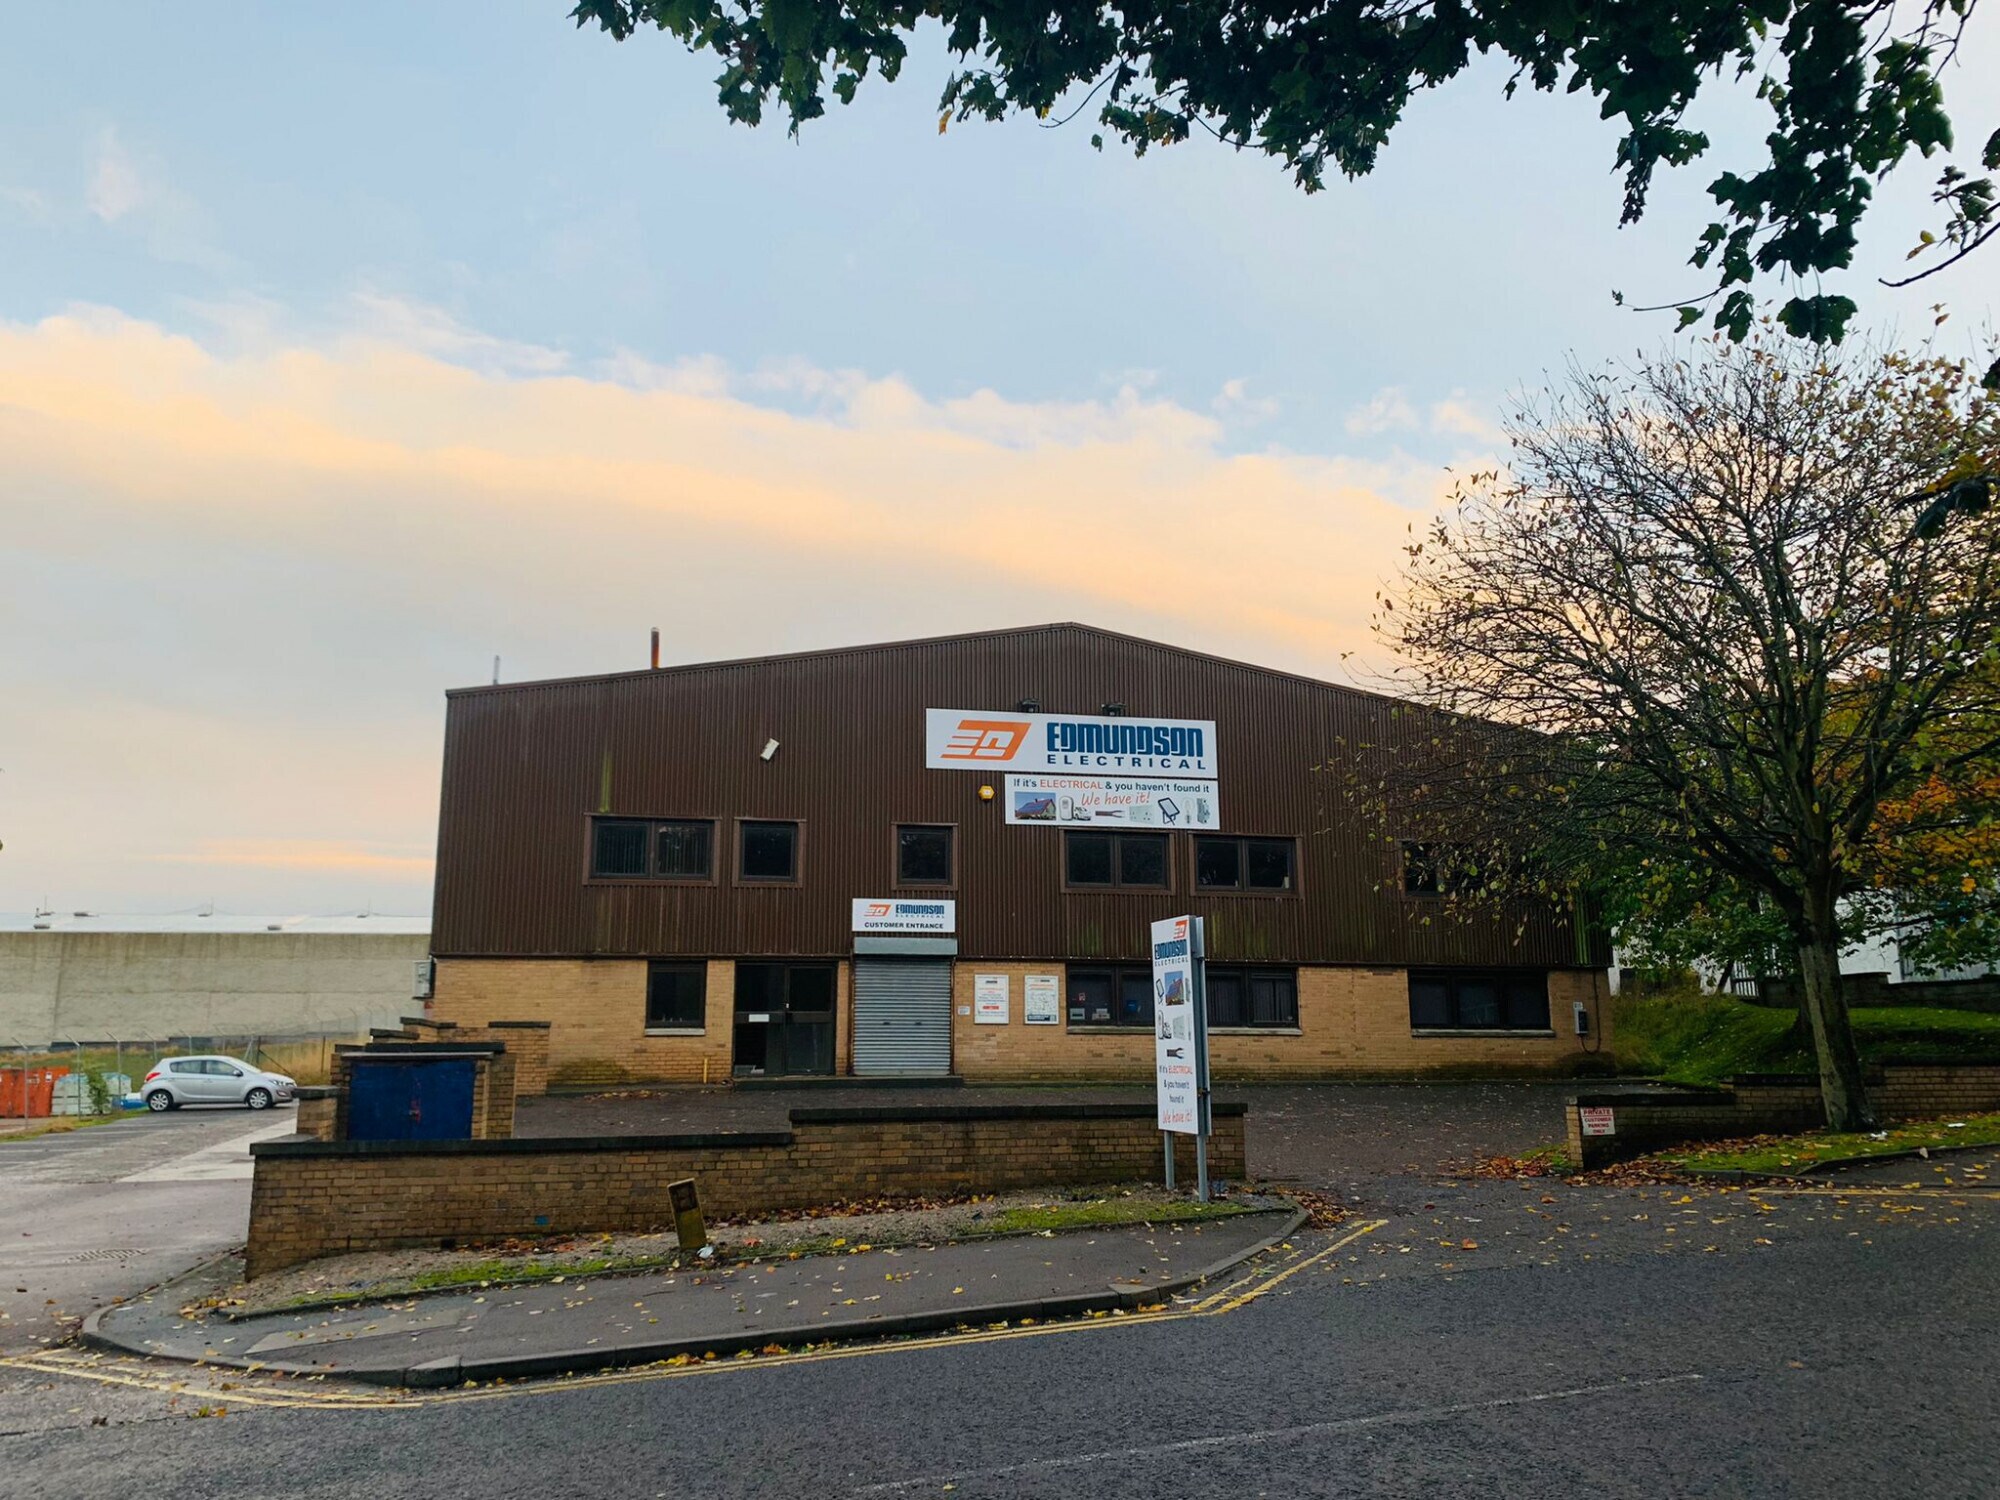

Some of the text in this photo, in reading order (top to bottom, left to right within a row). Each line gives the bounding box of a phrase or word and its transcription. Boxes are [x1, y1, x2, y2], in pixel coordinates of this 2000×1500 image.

[1046, 721, 1204, 757] EDMUNDSON
[1046, 754, 1206, 770] ELECTRICAL
[1013, 778, 1209, 793] If it's ELECTRICAL & you haven't found it
[1081, 791, 1151, 806] We have it!
[895, 903, 945, 915] EDMUNDSON
[1155, 957, 1188, 966] ELECTRICAL
